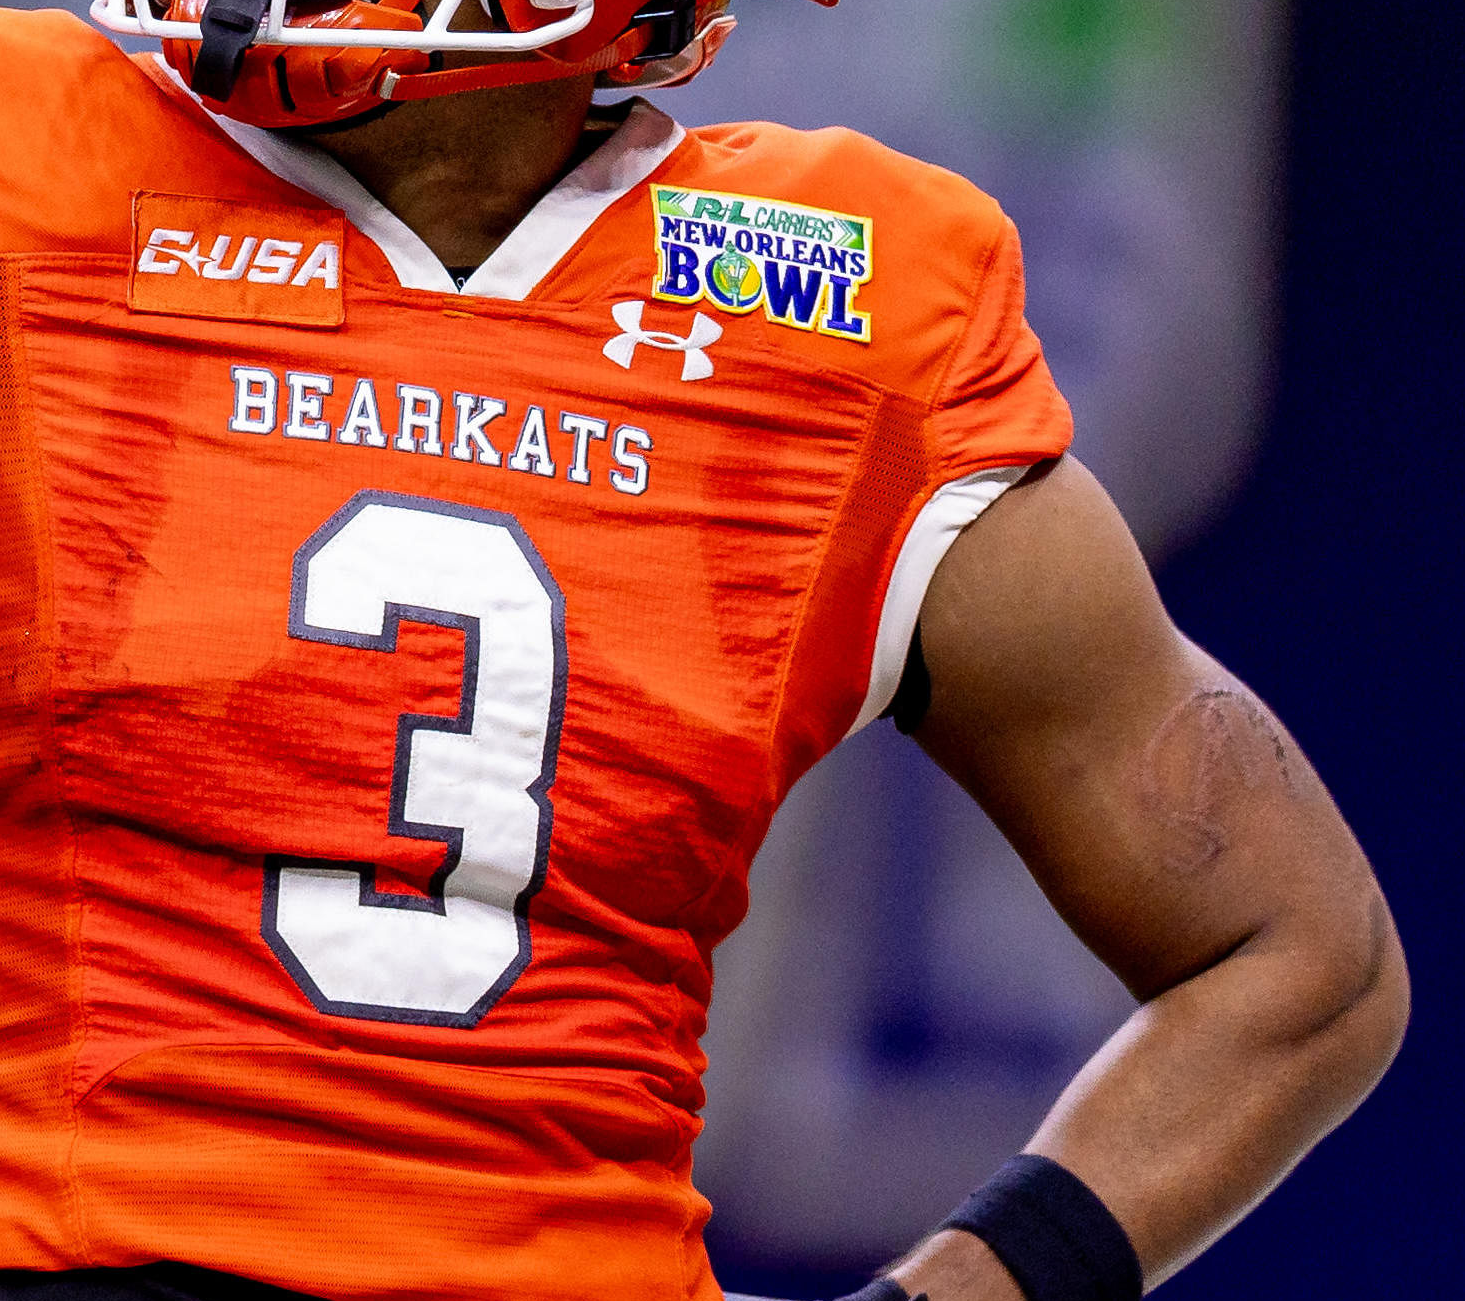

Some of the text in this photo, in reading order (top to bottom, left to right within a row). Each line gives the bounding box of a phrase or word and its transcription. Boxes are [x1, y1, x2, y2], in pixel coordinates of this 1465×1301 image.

[660, 215, 866, 277] NEW ORLEANS
[754, 205, 835, 243] CARRIERS
[658, 240, 864, 335] BOWL
[228, 364, 654, 497] BEARKATS
[260, 489, 566, 1029] 3
